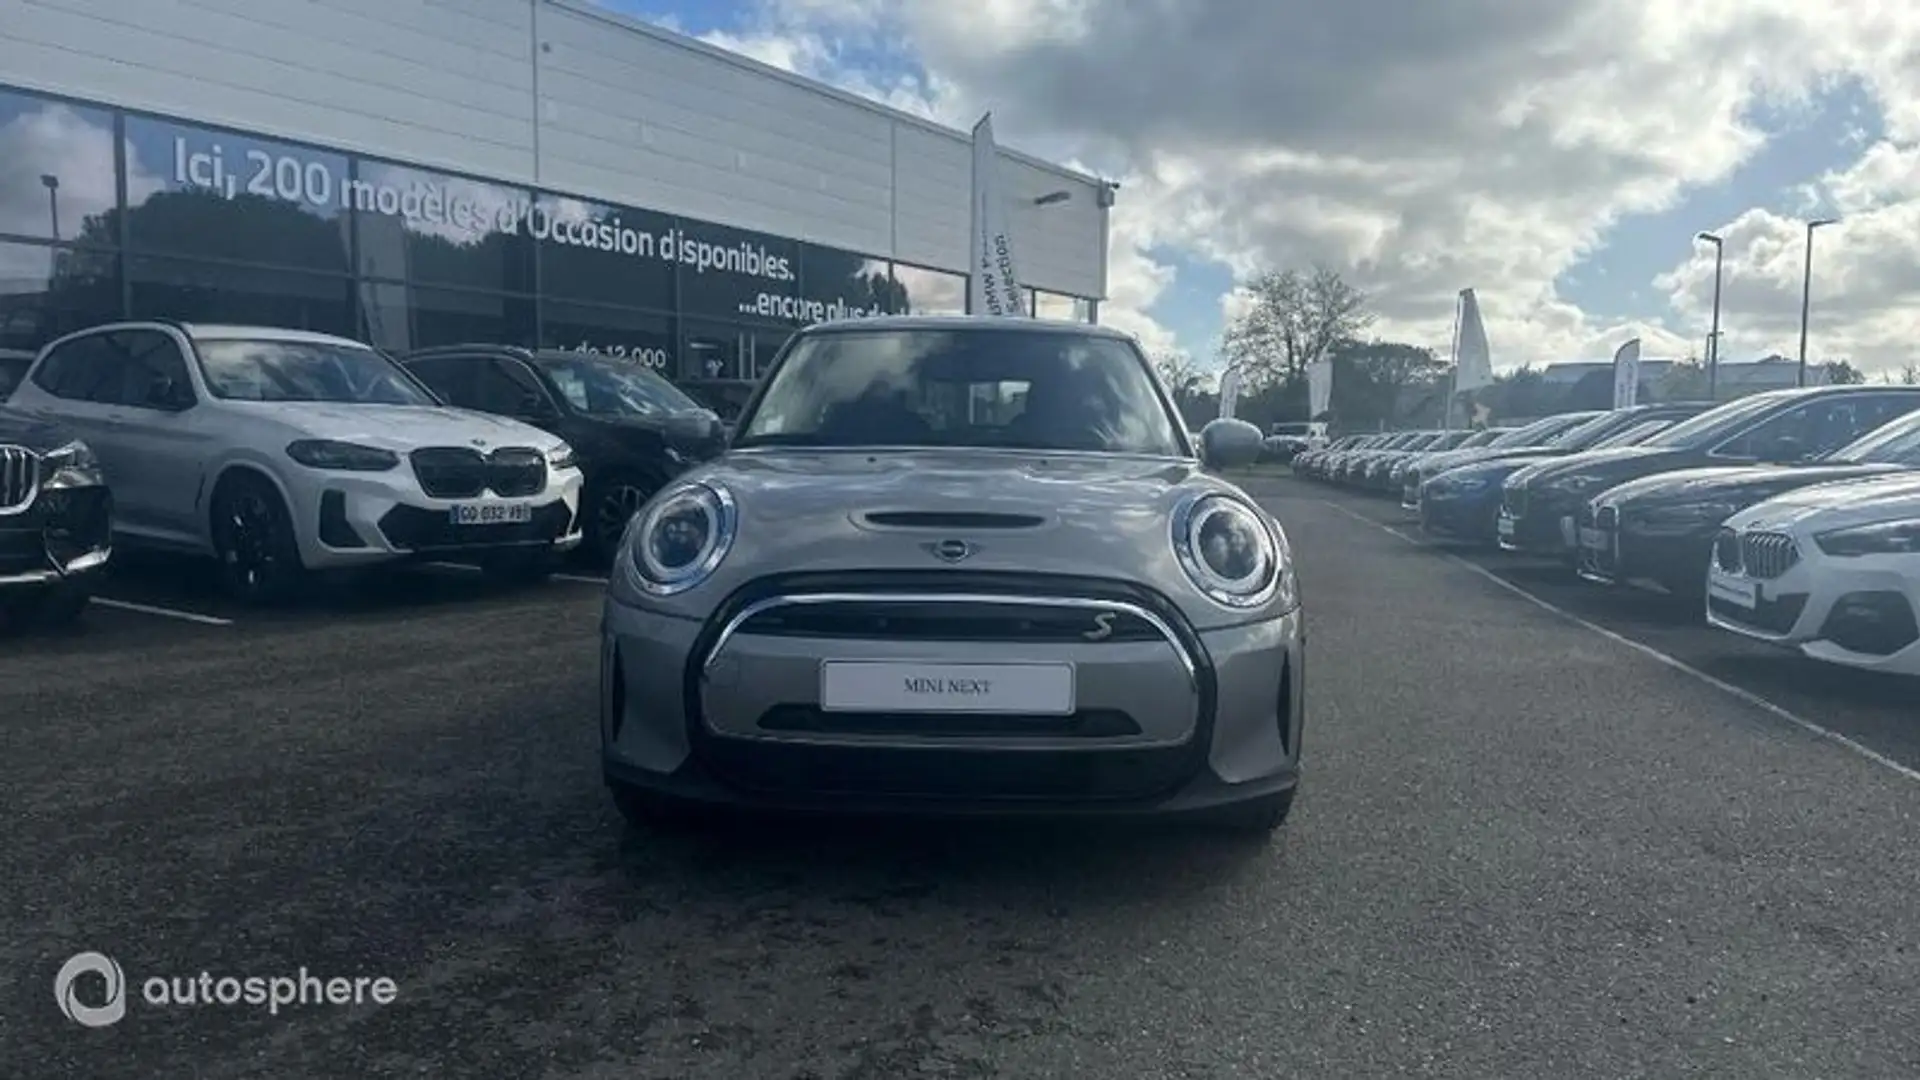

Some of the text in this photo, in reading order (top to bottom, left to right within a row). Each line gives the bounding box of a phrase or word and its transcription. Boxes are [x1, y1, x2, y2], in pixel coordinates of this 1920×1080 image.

[174, 137, 795, 281] Ici, 200 modèles d'Occasion disponibles.
[739, 292, 824, 323] ...encore
[1083, 611, 1116, 639] S
[903, 678, 991, 695] MINI NEXT
